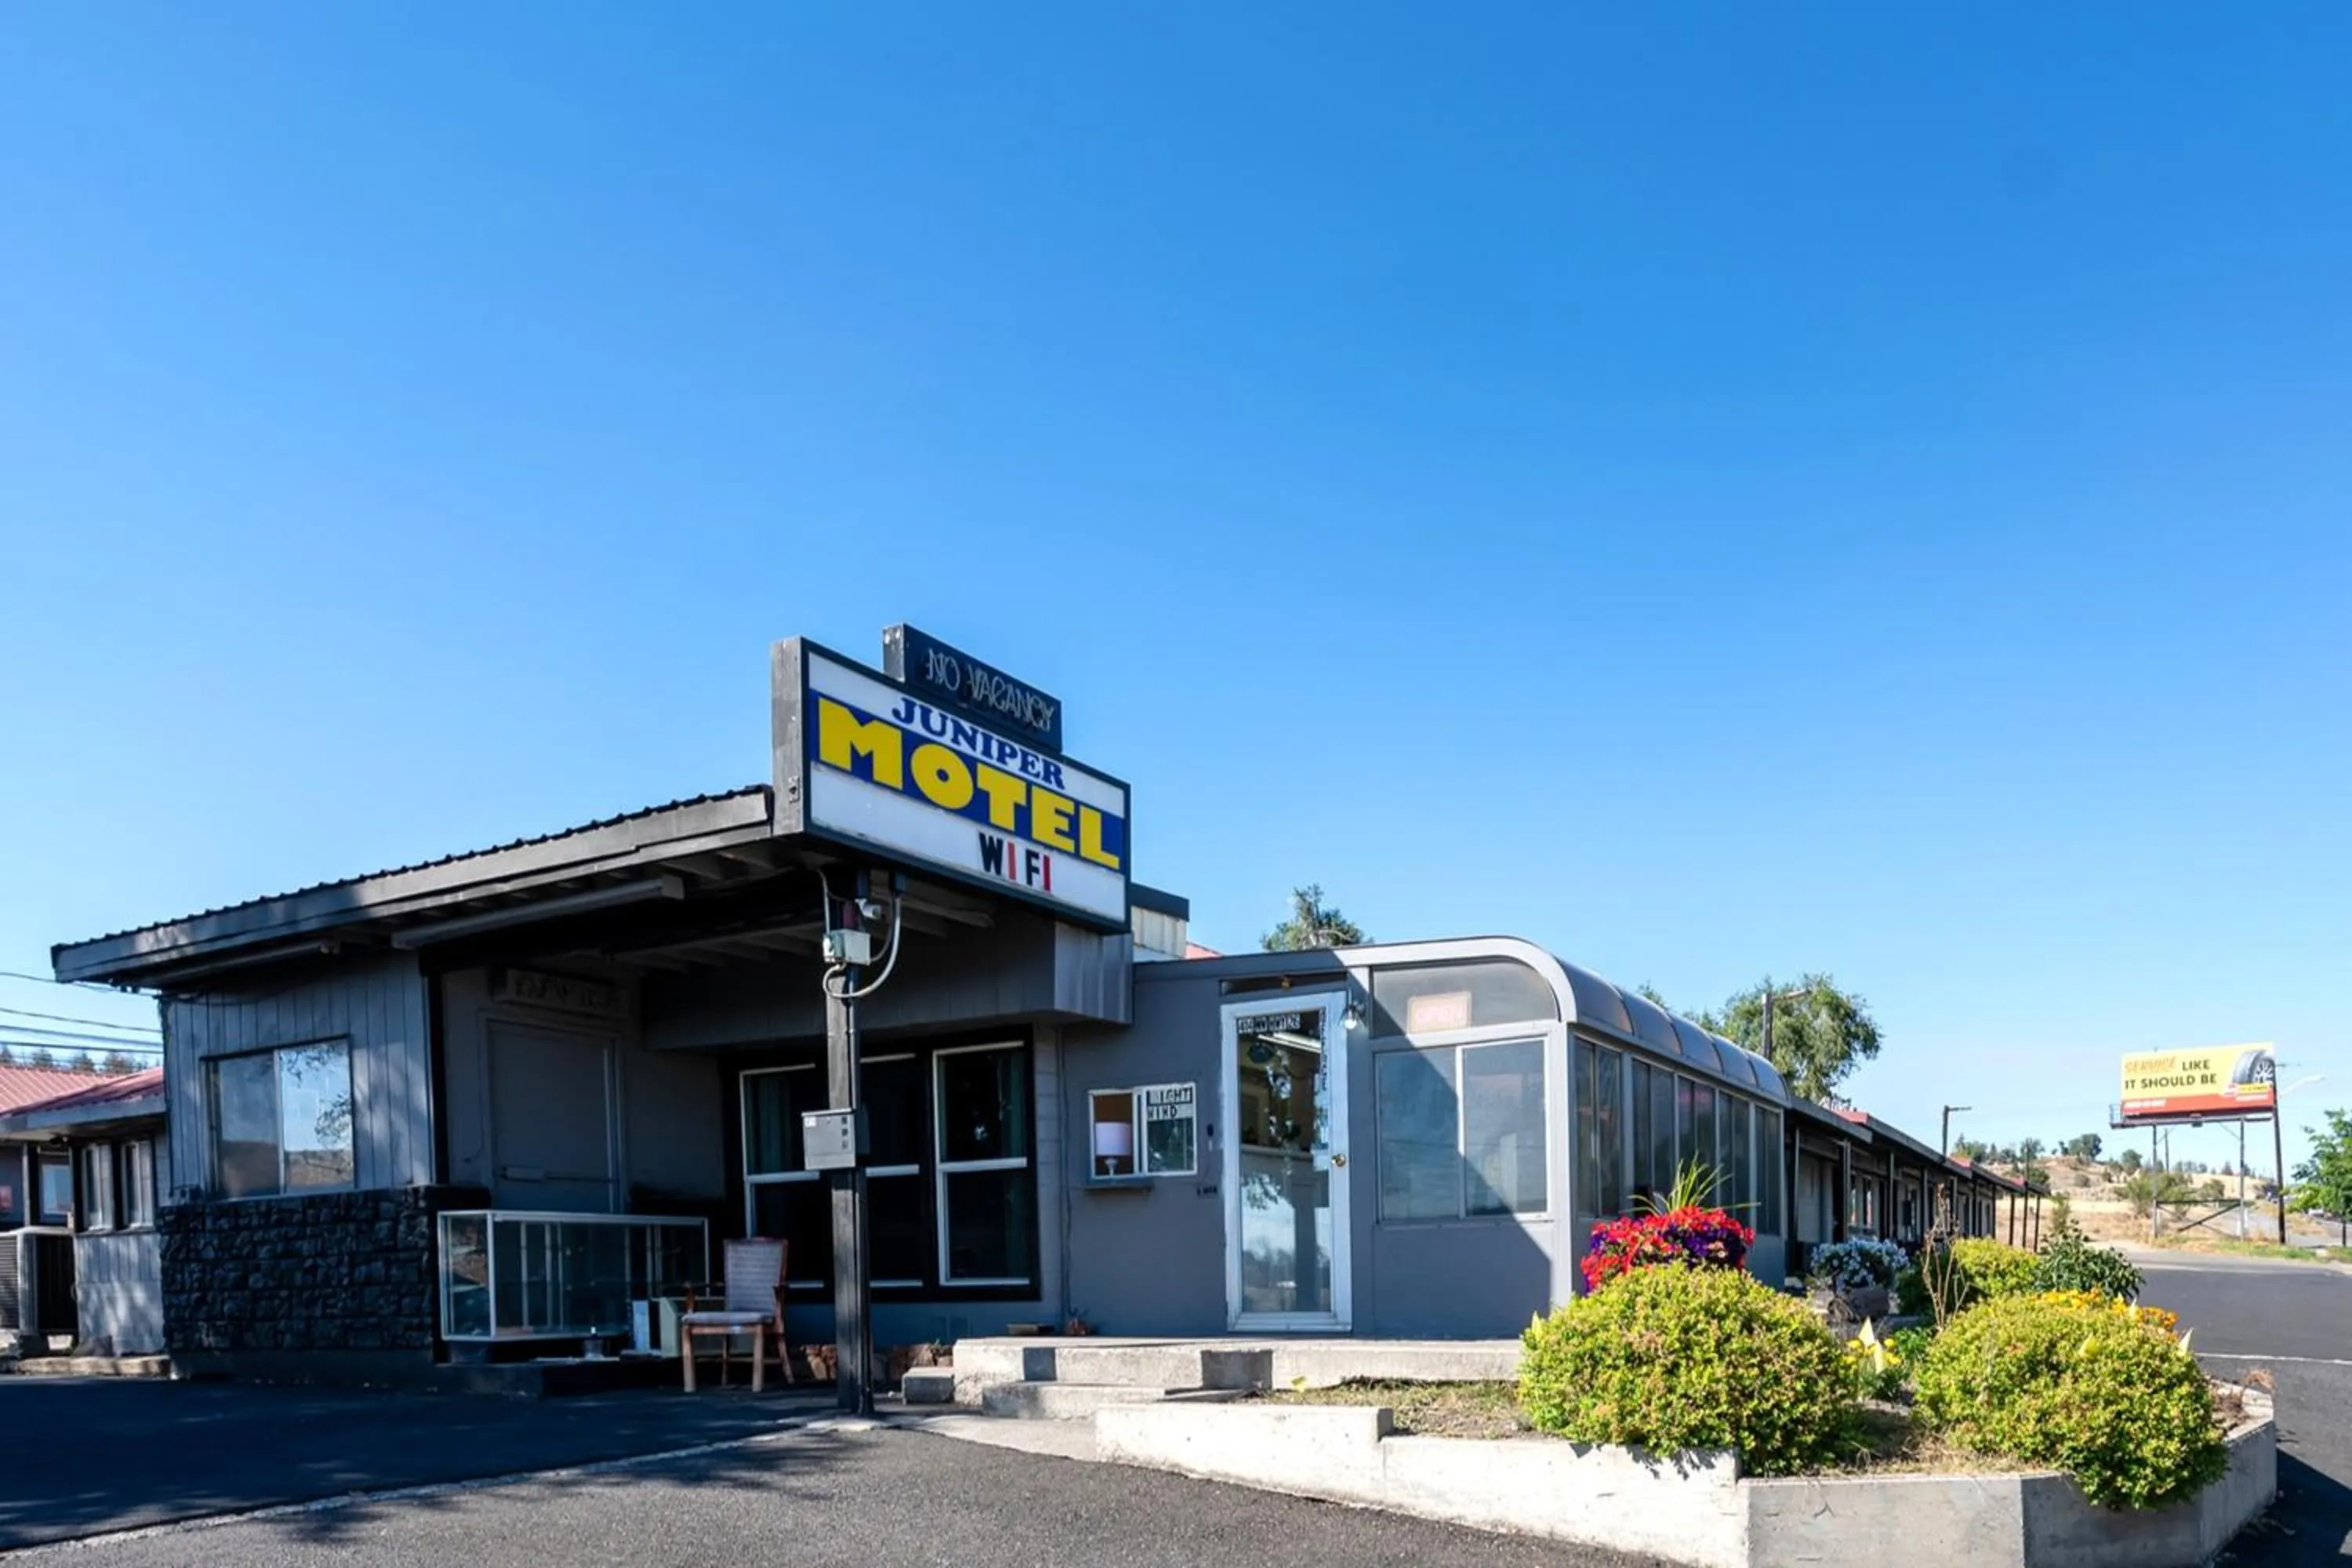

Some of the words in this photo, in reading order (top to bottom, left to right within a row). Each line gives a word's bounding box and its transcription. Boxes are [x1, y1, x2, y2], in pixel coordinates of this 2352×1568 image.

[925, 648, 960, 691] NO
[965, 663, 1054, 732] VACANCY
[892, 696, 1065, 790] JUNIPER
[817, 696, 1120, 870] MOTEL
[978, 832, 1051, 892] WIFI
[2125, 1056, 2176, 1073] SERVICE
[2182, 1059, 2210, 1072] LIKE
[2125, 1079, 2136, 1090] IT
[2141, 1075, 2195, 1089] SHOULD
[2200, 1073, 2216, 1084] BE
